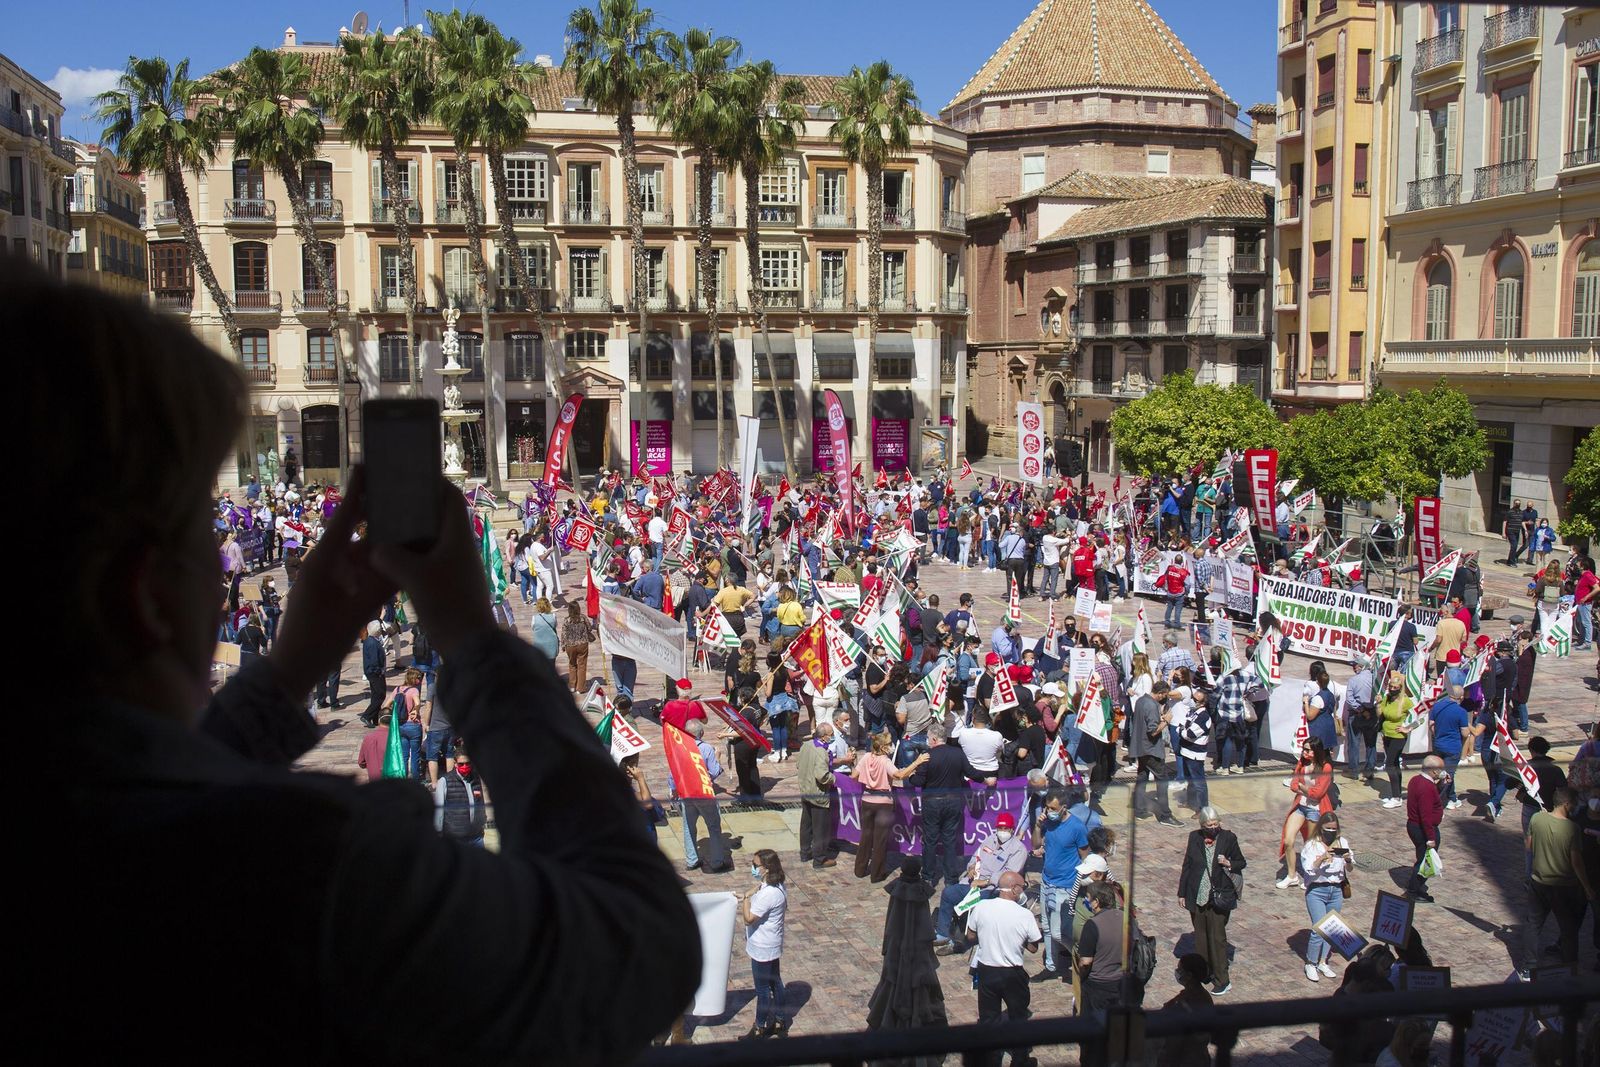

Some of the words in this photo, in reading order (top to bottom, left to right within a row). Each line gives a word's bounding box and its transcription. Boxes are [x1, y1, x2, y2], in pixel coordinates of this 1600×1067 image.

[1251, 455, 1273, 532] CCOO
[1262, 579, 1337, 606] TRABAJADORES
[1339, 593, 1354, 610] del
[1359, 596, 1393, 618] METRO
[1318, 627, 1326, 644] Y
[1368, 618, 1378, 635] Y
[1381, 919, 1402, 937] H&M
